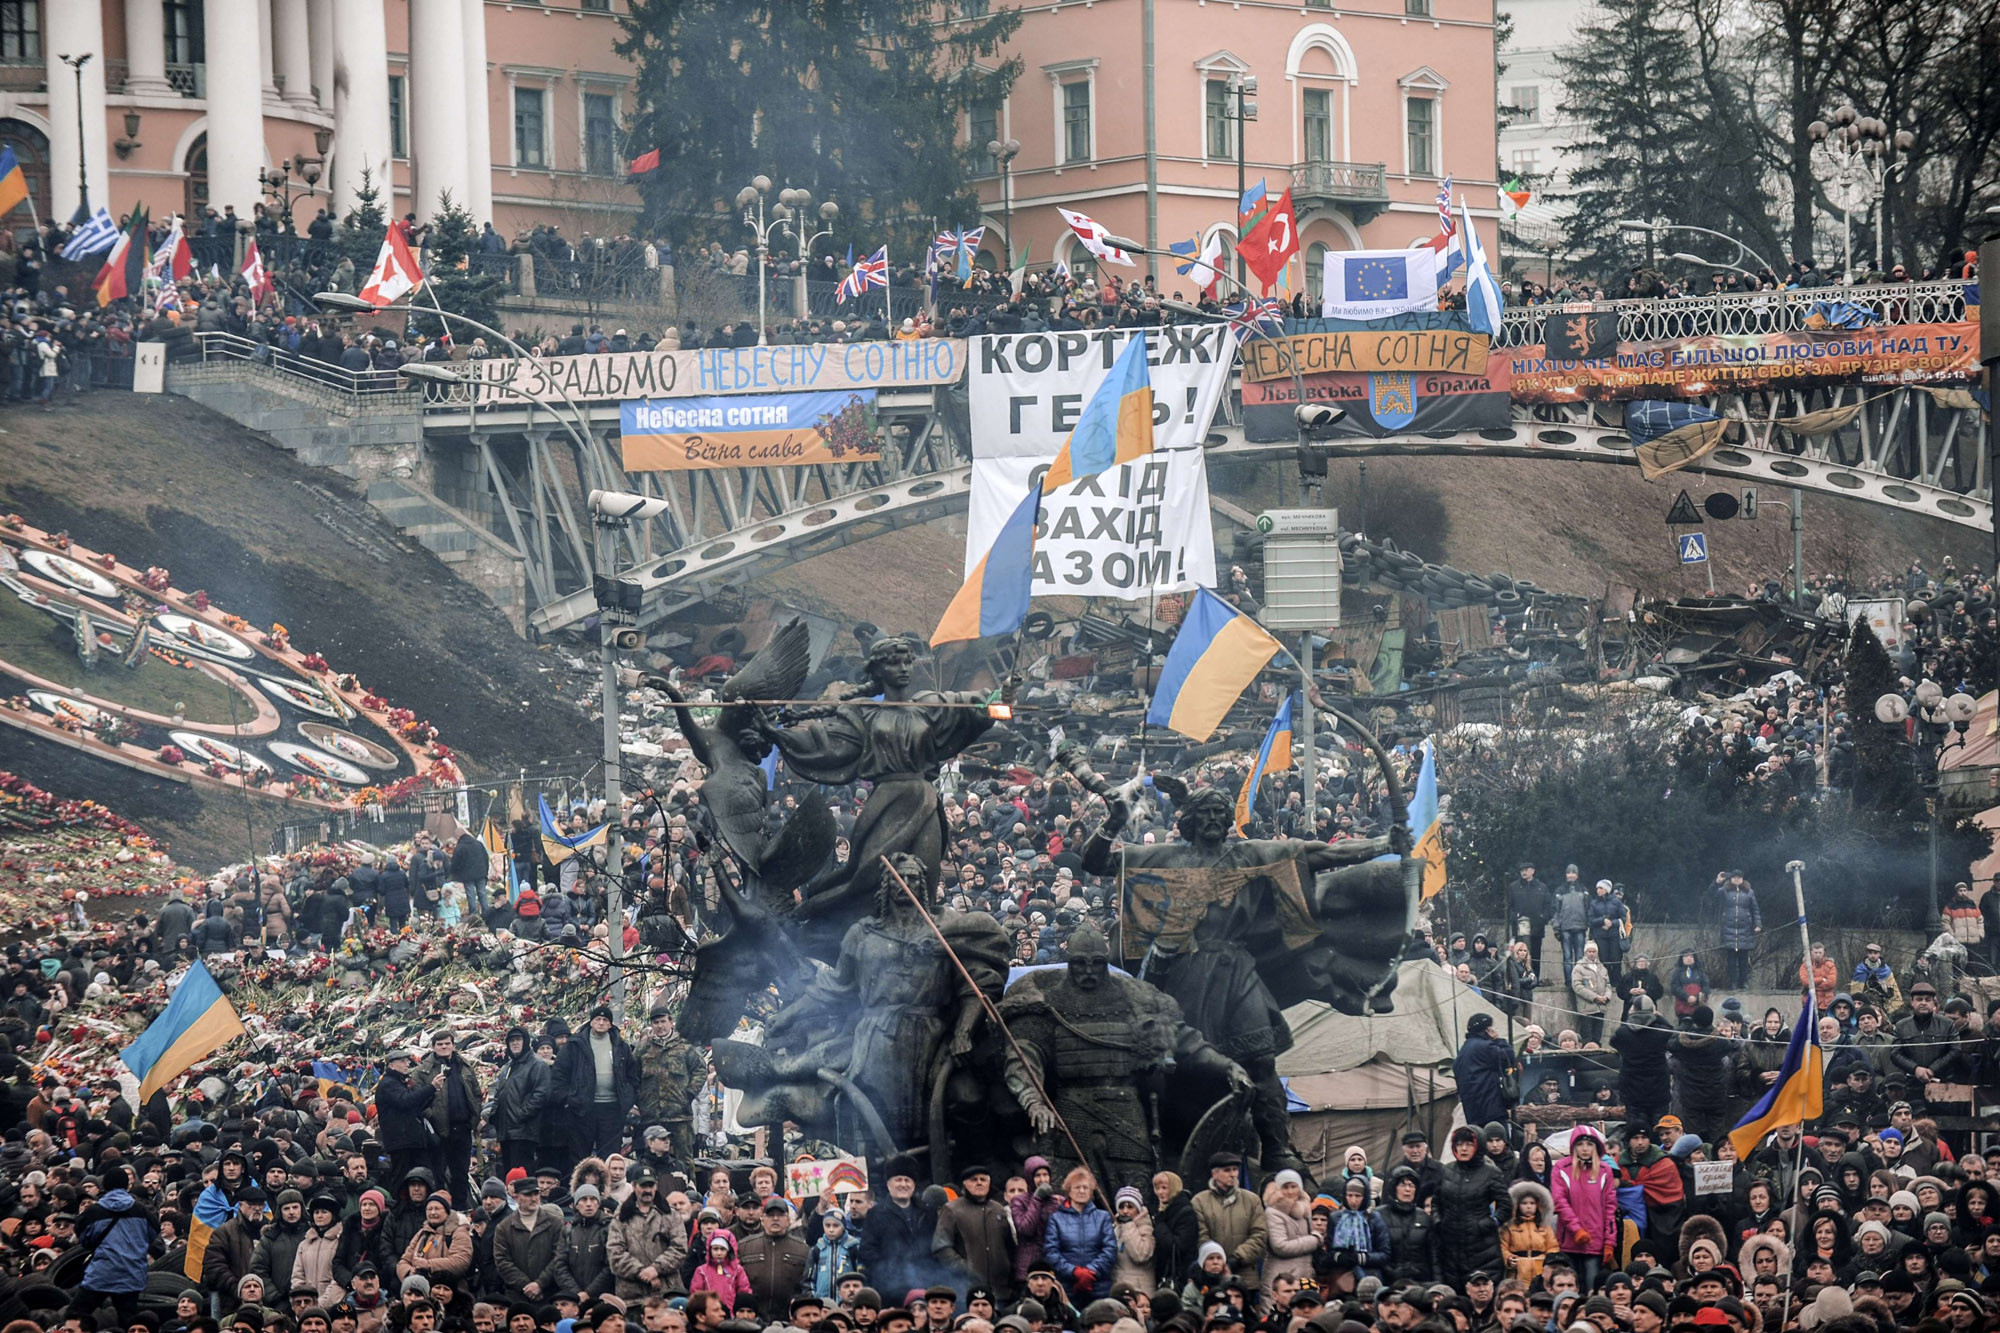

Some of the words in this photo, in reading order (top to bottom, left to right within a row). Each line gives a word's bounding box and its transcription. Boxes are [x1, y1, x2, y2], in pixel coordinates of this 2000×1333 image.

[1331, 305, 1341, 315] Ми
[1343, 306, 1374, 315] любимо
[487, 362, 521, 399] НЕ
[526, 354, 677, 397] ЗРАДЬМО
[698, 345, 827, 391] НЕБЕСНУ
[844, 340, 954, 382] СОТНЮ
[1243, 334, 1357, 380] НЕБЕСНА
[1376, 332, 1471, 370] СОТНЯ
[1512, 358, 1577, 375] НІХТО
[1617, 352, 1665, 369] МАЄ
[1671, 343, 1766, 367] БІЛЬШОЇ
[1773, 339, 1873, 361] ЛЮБОВИ
[1881, 336, 1928, 355] НАД
[1935, 335, 1969, 353] ТУ,
[1260, 382, 1363, 402] Льввська
[1425, 376, 1491, 398] брама
[1516, 377, 1538, 392] ЯК
[1542, 374, 1599, 390] ХТОСЬ
[1603, 370, 1686, 387] ПОКЛАДЕ
[1690, 366, 1753, 382] ЖИТТЯ
[1757, 364, 1807, 379] СВОЄ
[1811, 362, 1834, 376] ЗА
[1839, 358, 1901, 375] ДРУЗІВ
[636, 406, 723, 429] Небесна
[727, 405, 788, 426] сотня
[1009, 387, 1198, 434] ГЕЬ!
[684, 435, 742, 461] Вічна
[748, 433, 805, 459] слава
[1031, 546, 1187, 588] АЗОМ!
